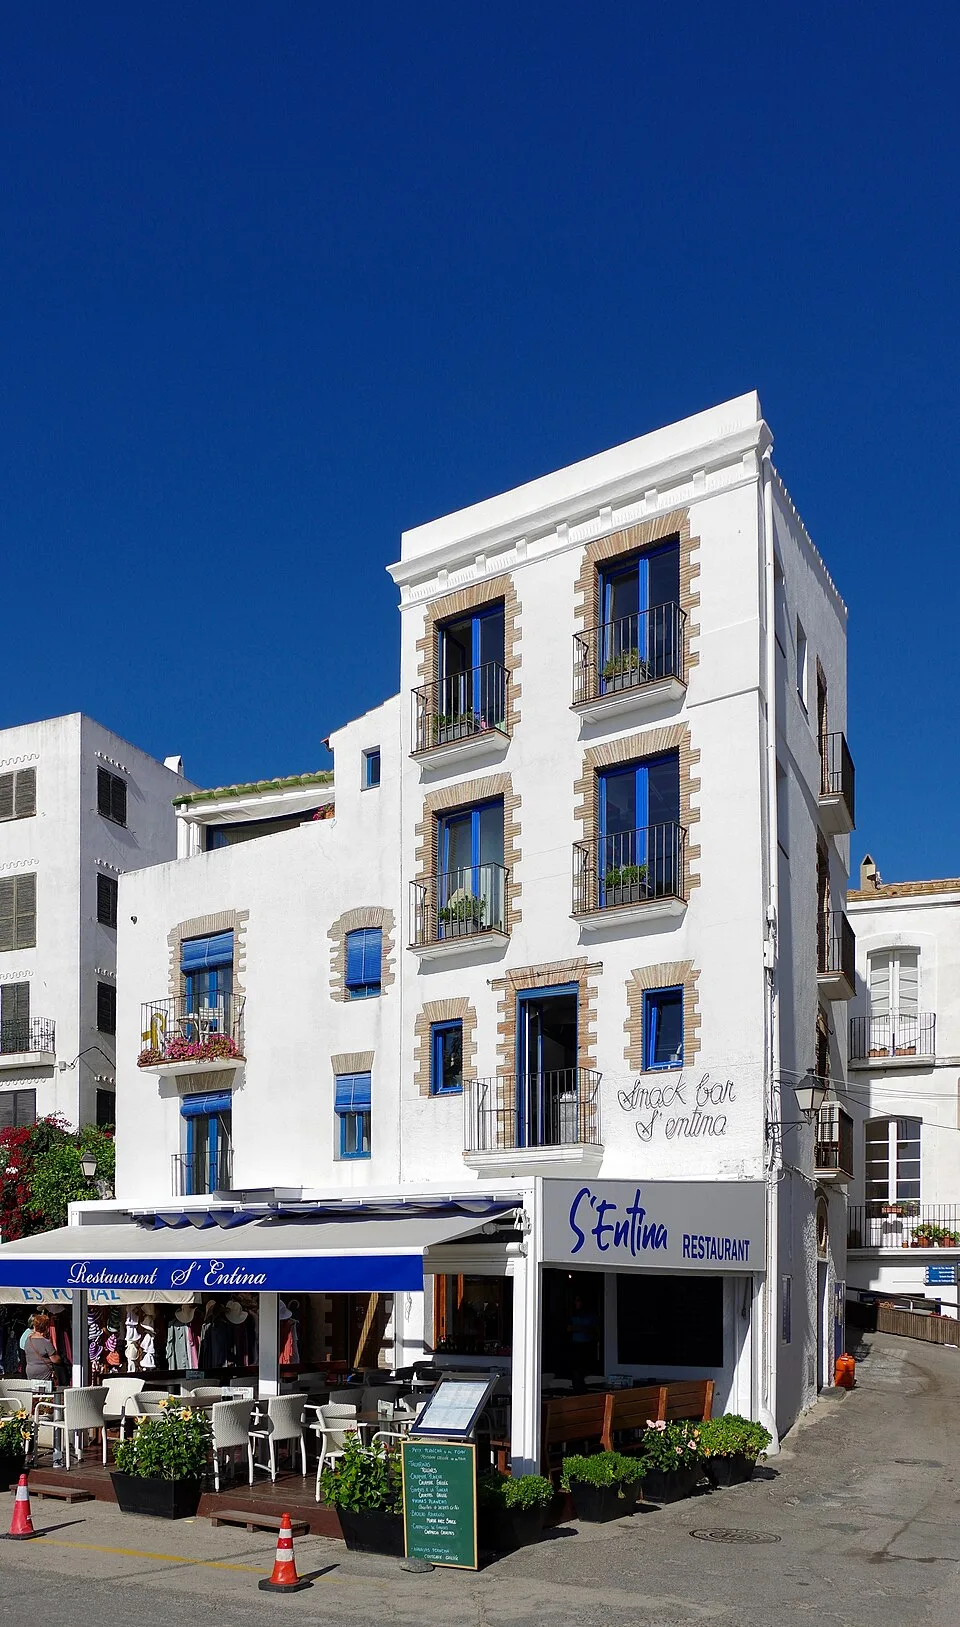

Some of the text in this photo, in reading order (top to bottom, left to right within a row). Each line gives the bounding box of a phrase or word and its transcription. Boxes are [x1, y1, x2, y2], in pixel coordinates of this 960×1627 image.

[617, 1072, 738, 1112] Snack bar
[682, 1233, 751, 1262] RESTAURANT
[66, 1260, 158, 1285] Restaurant
